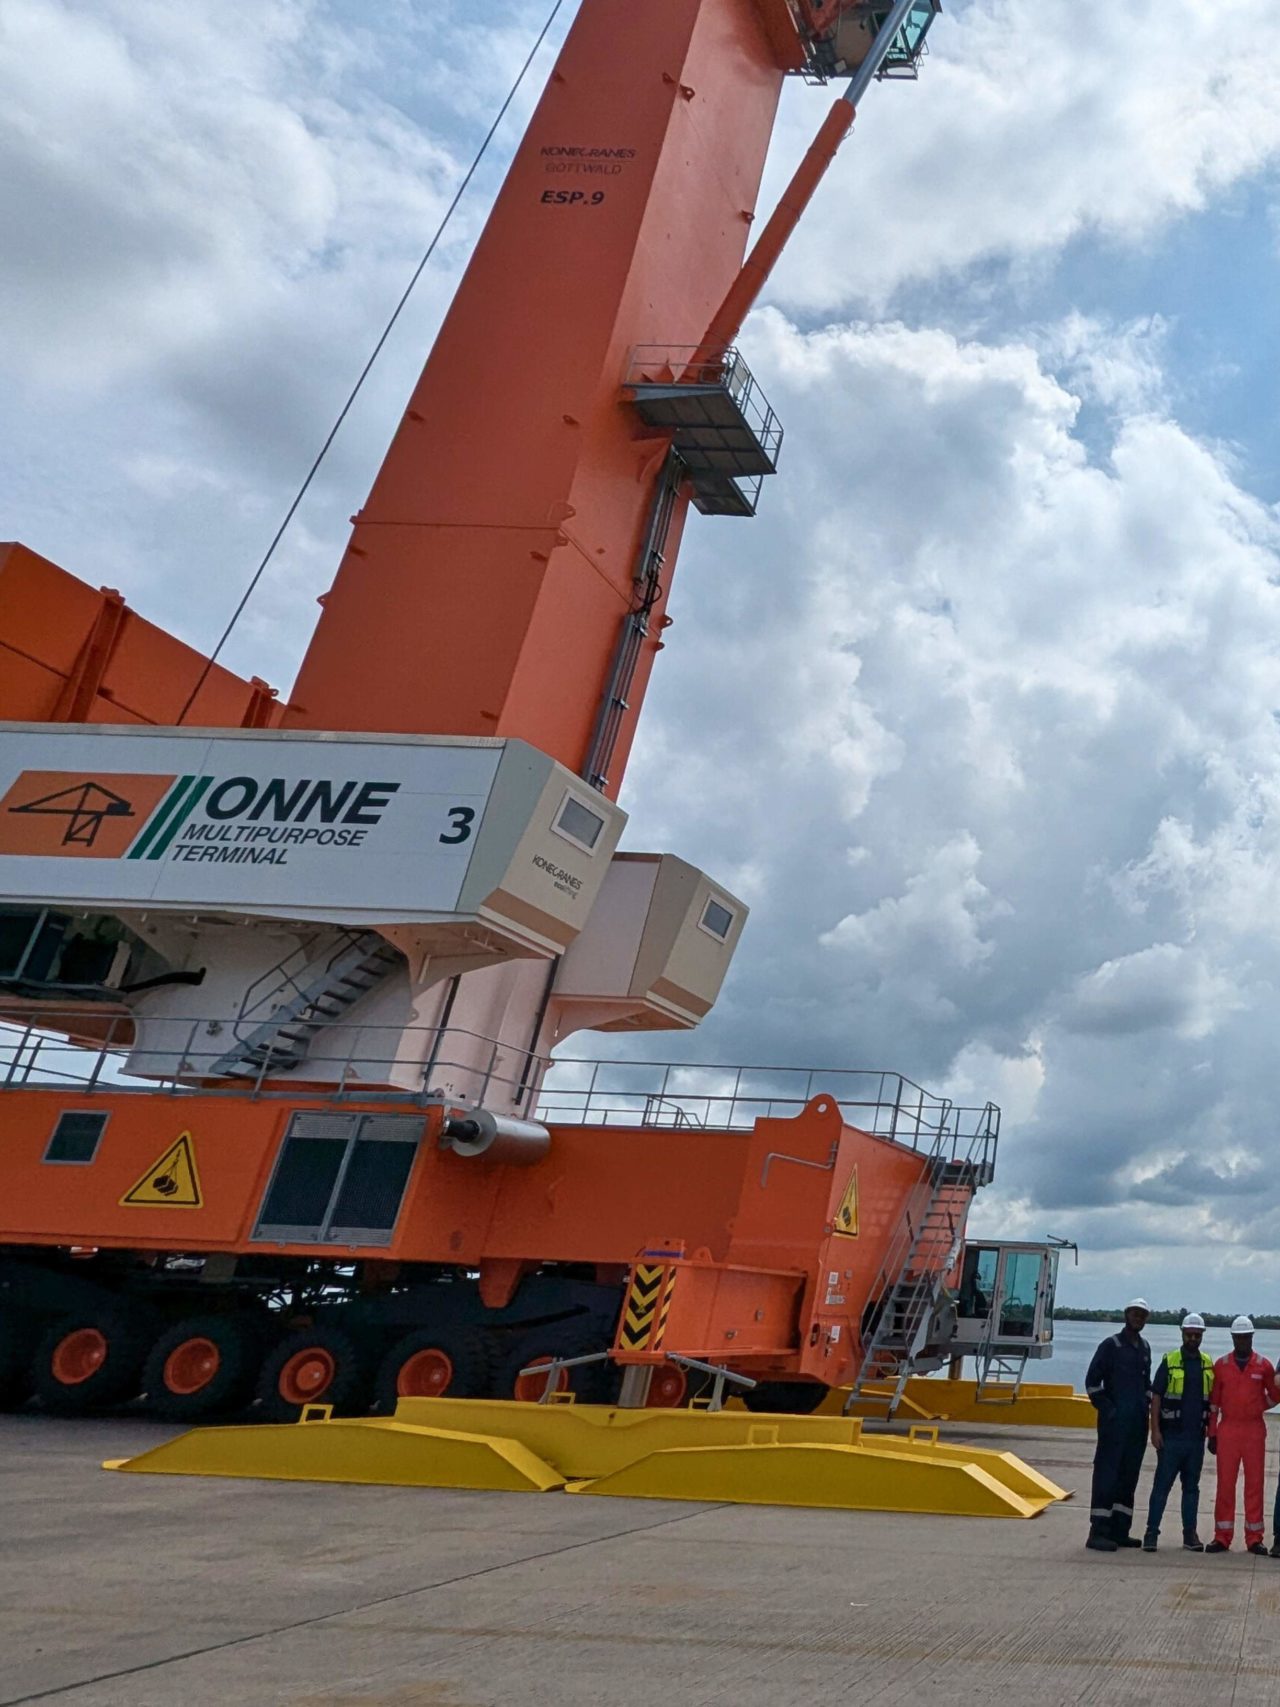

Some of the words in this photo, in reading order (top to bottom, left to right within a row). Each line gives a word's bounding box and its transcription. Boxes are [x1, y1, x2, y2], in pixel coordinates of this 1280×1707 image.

[541, 190, 605, 205] ESP.9
[205, 776, 402, 825] ONNE
[181, 823, 368, 846] MULTIPURPOSE
[439, 807, 475, 844] 3
[171, 845, 288, 865] TERMINAL
